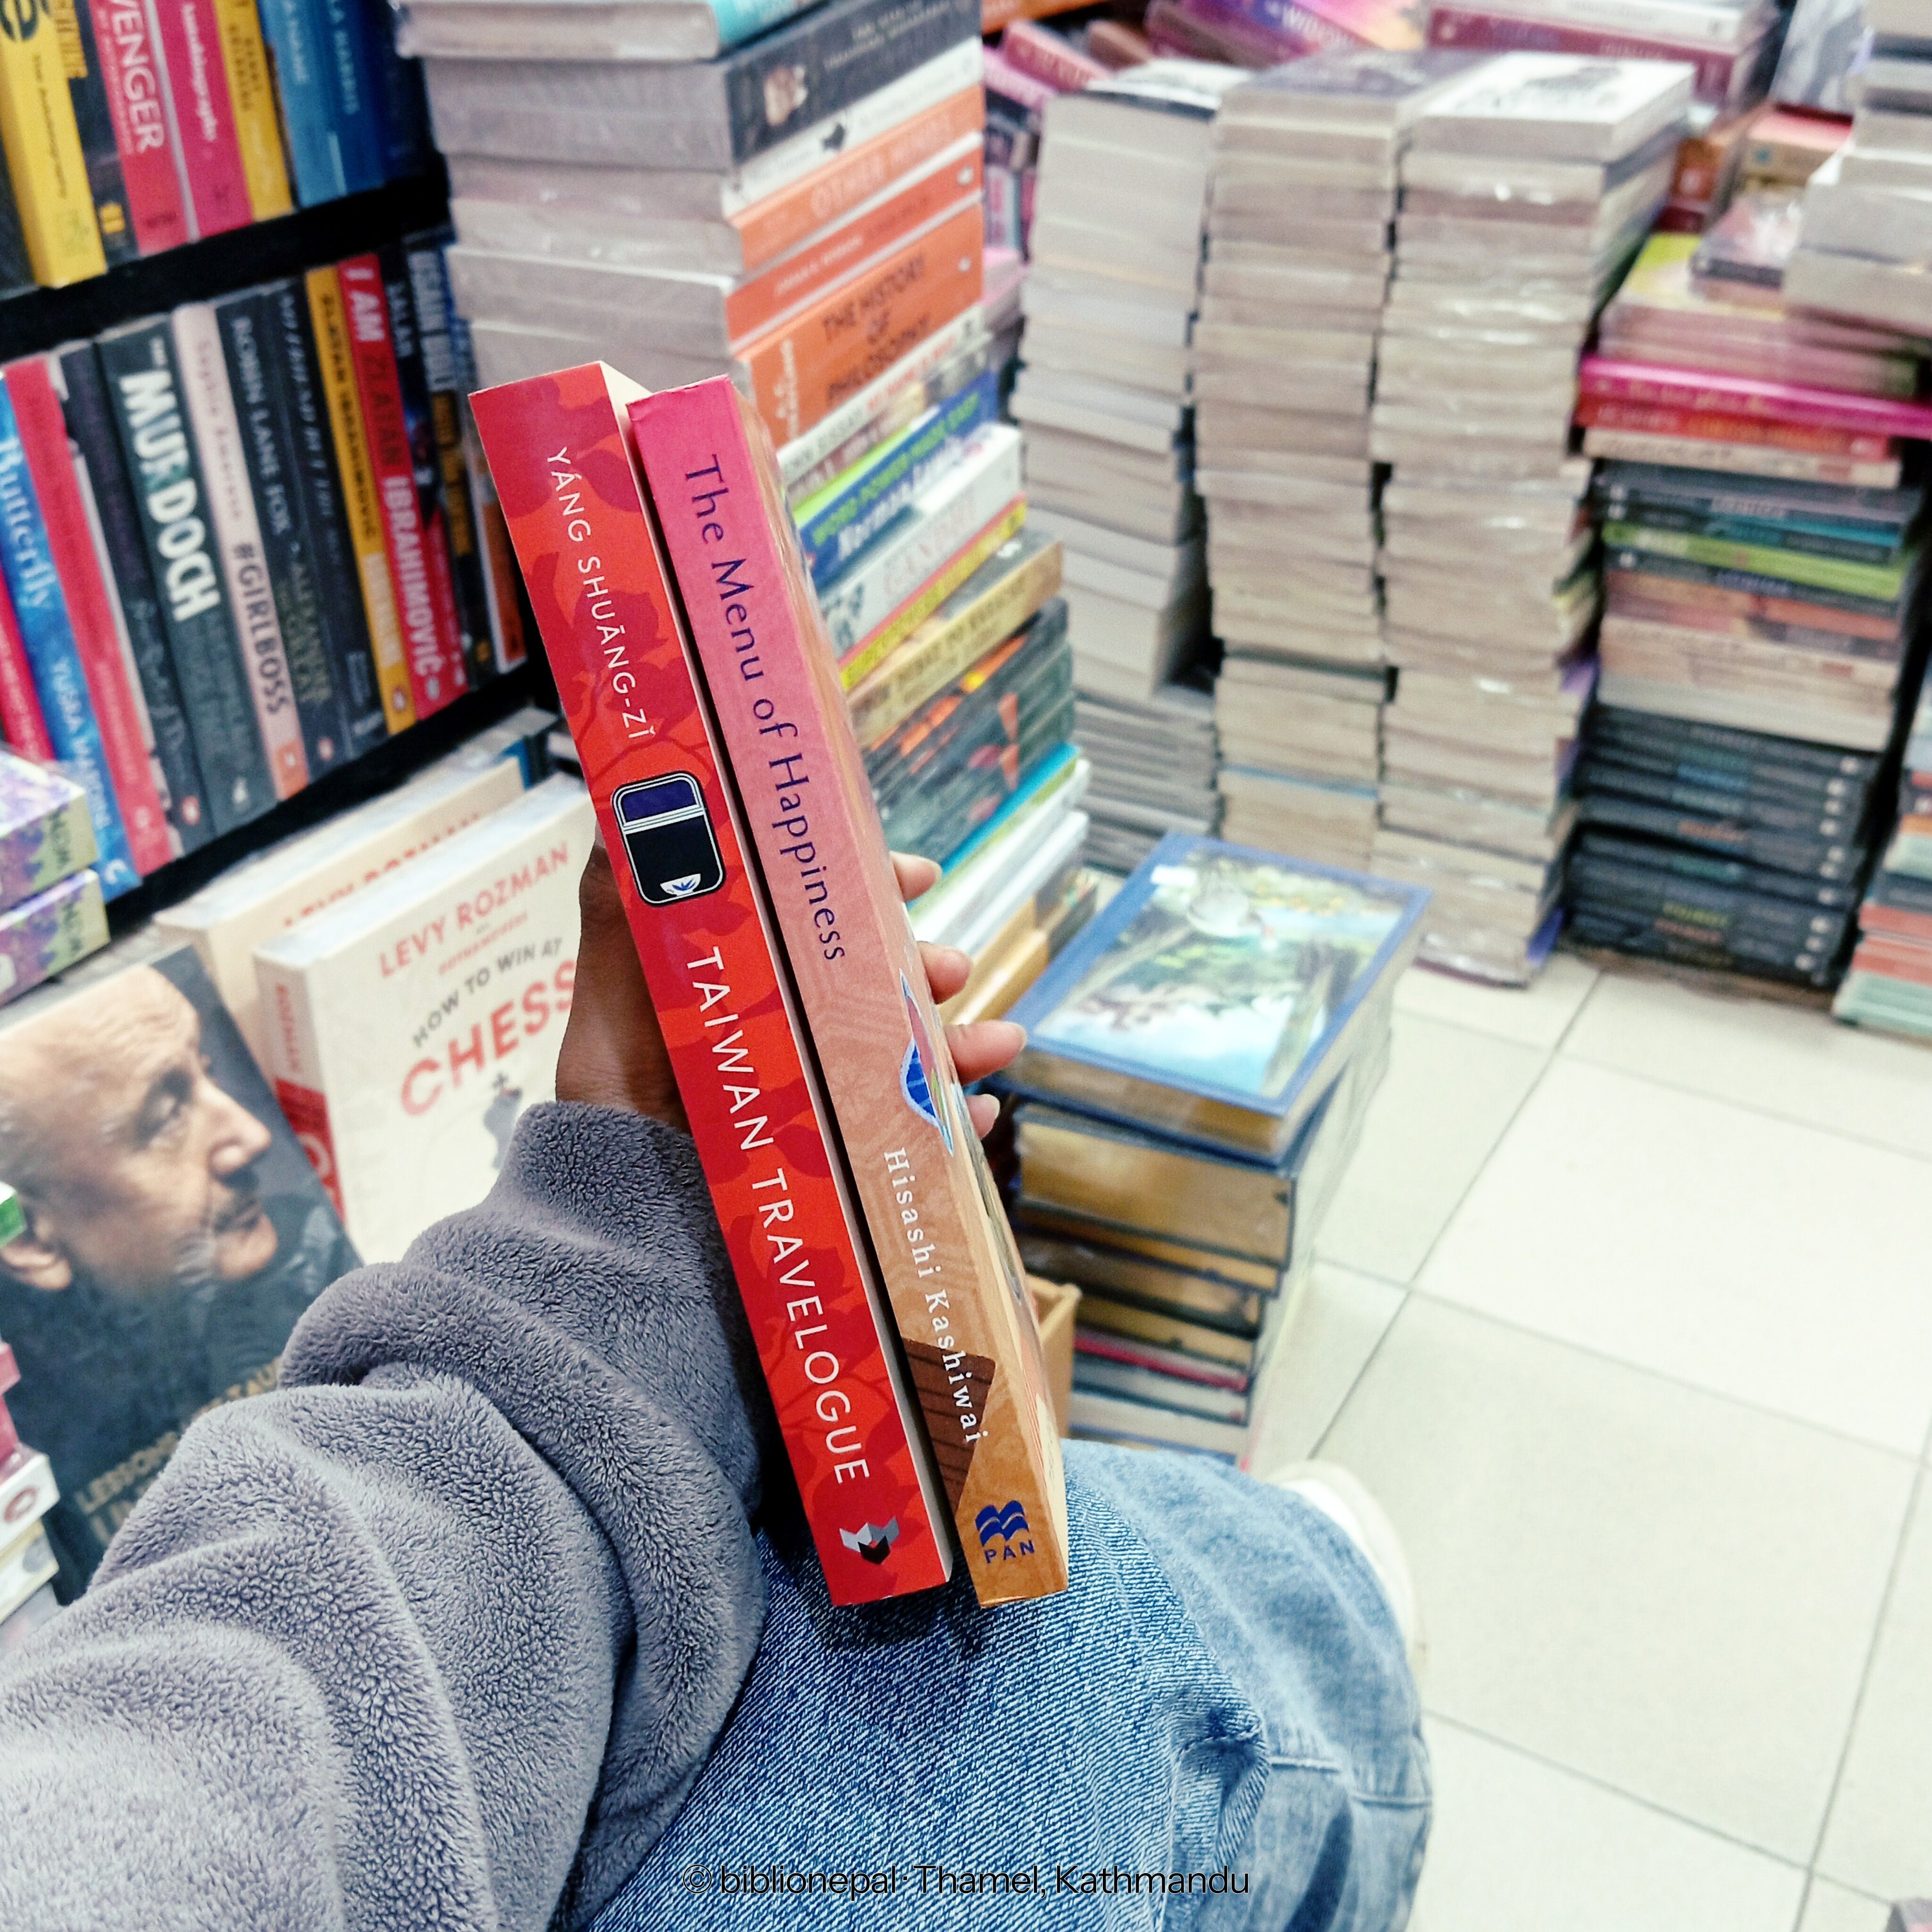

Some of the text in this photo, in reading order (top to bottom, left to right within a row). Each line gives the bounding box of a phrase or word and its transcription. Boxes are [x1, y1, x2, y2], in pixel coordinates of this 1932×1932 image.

[344, 264, 374, 285] I
[346, 286, 385, 347] AM
[0, 436, 60, 614] Butterfly
[119, 369, 221, 623] MURDOCH
[383, 471, 449, 680] IBRAHIMOVIĆ
[547, 446, 591, 542] YÁNG
[233, 542, 290, 715] #GIRLBOSS
[685, 453, 846, 961] The Menu of Happiness
[378, 916, 447, 977] LEVY
[457, 842, 569, 930] ROZMAN
[401, 959, 576, 1115] CHESS
[412, 938, 562, 1047] HOW TO WIN AT
[686, 946, 869, 1484] TAIWAN TRAVELOGUE
[883, 1146, 988, 1443] Hisashi Kashiwai
[984, 1539, 1034, 1564] PAN
